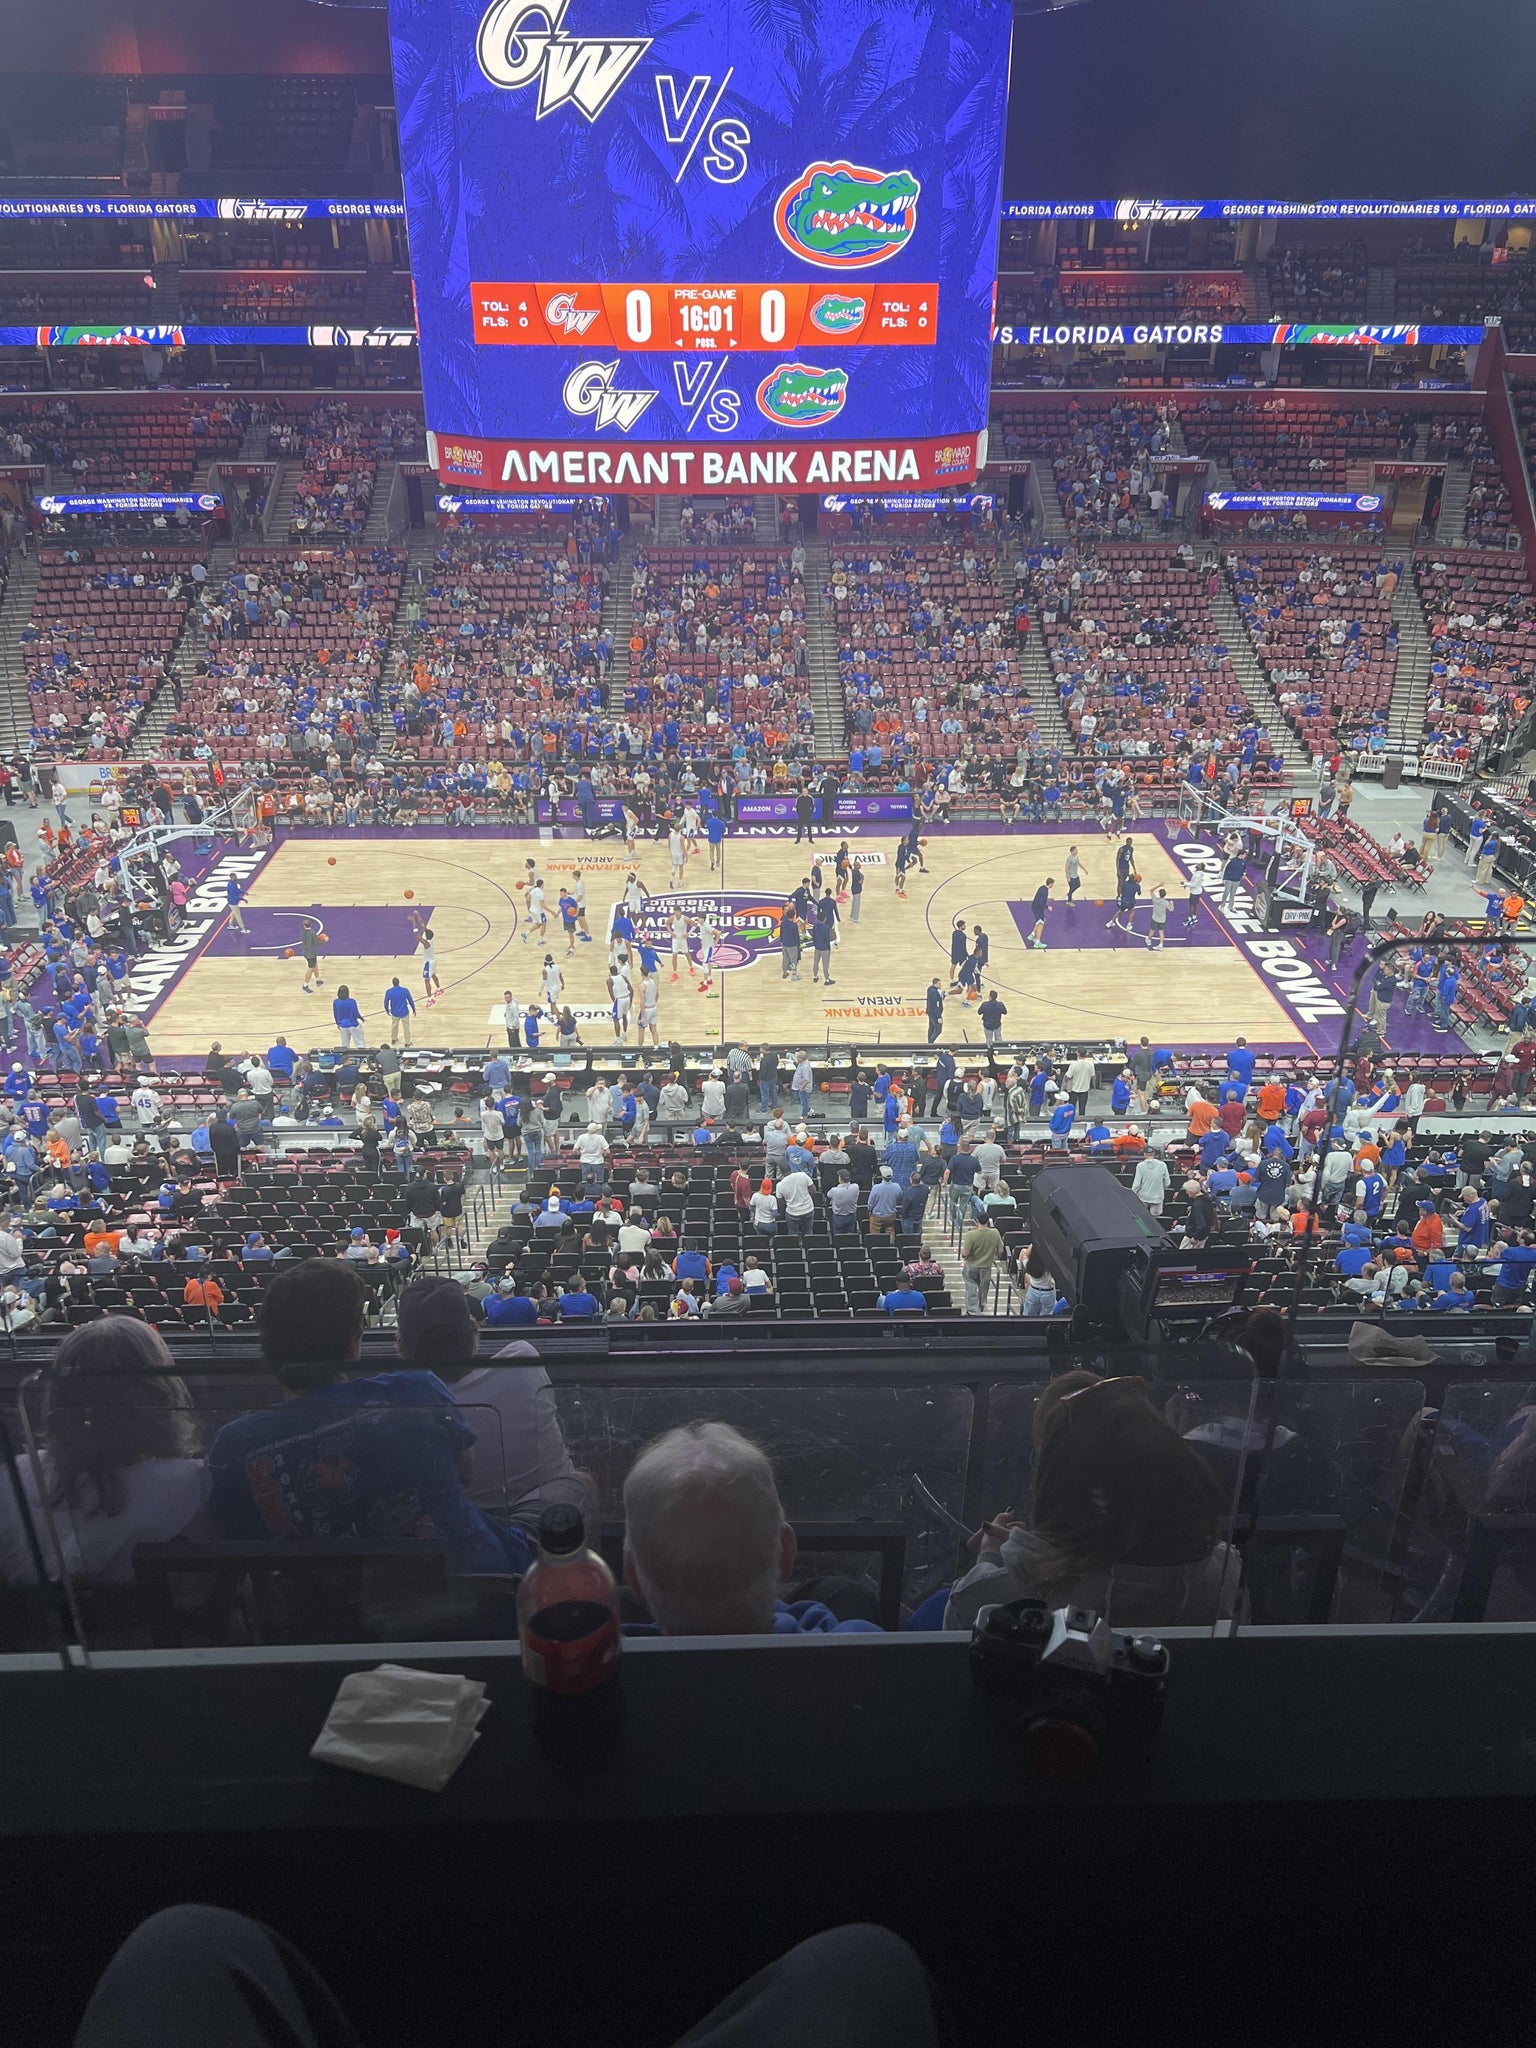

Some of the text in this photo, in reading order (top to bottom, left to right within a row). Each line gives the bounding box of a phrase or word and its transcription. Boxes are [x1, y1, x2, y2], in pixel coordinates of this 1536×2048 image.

[87, 204, 105, 213] VS.
[108, 204, 152, 213] FLORIDA
[155, 204, 197, 213] GATORS
[328, 204, 371, 214] GEORGE
[1009, 206, 1094, 215] FLORIDA GATORS
[1223, 205, 1264, 214] GEORGE
[1267, 205, 1337, 214] WASHINGTON
[1340, 204, 1440, 214] REVOLUTIONARIES
[1443, 204, 1460, 214] VS.
[1463, 204, 1510, 214] FLORIDA
[674, 289, 737, 301] PRE-GAME
[481, 302, 528, 312] TOL: 4
[882, 302, 928, 312] TOL: 4
[626, 289, 652, 343] 0
[680, 305, 733, 332] 16:01
[760, 289, 786, 343] 0
[482, 317, 528, 327] FLS: 0
[881, 317, 928, 327] FLS: 0
[1029, 326, 1125, 344] FLORIDA
[1133, 325, 1223, 344] GATORS
[695, 338, 717, 348] POSS.
[463, 460, 483, 470] COUNTY
[501, 449, 920, 484] AMERANT BANK ARENA
[952, 457, 970, 467] COUNTY
[221, 466, 233, 475] 115
[404, 466, 416, 475] 116
[1013, 465, 1027, 473] 120
[1194, 464, 1206, 473] 121
[1381, 465, 1396, 475] 121
[1421, 466, 1437, 475] 122
[546, 863, 641, 871] AMERANT BANK
[649, 899, 716, 908] Classic
[124, 851, 267, 1013] RANGE BOWL
[1244, 940, 1347, 1023] BOWL
[857, 996, 902, 1005] ARENA
[823, 1007, 928, 1018] MERANT BANK
[137, 1098, 151, 1109] 45
[1372, 1181, 1380, 1195] 2
